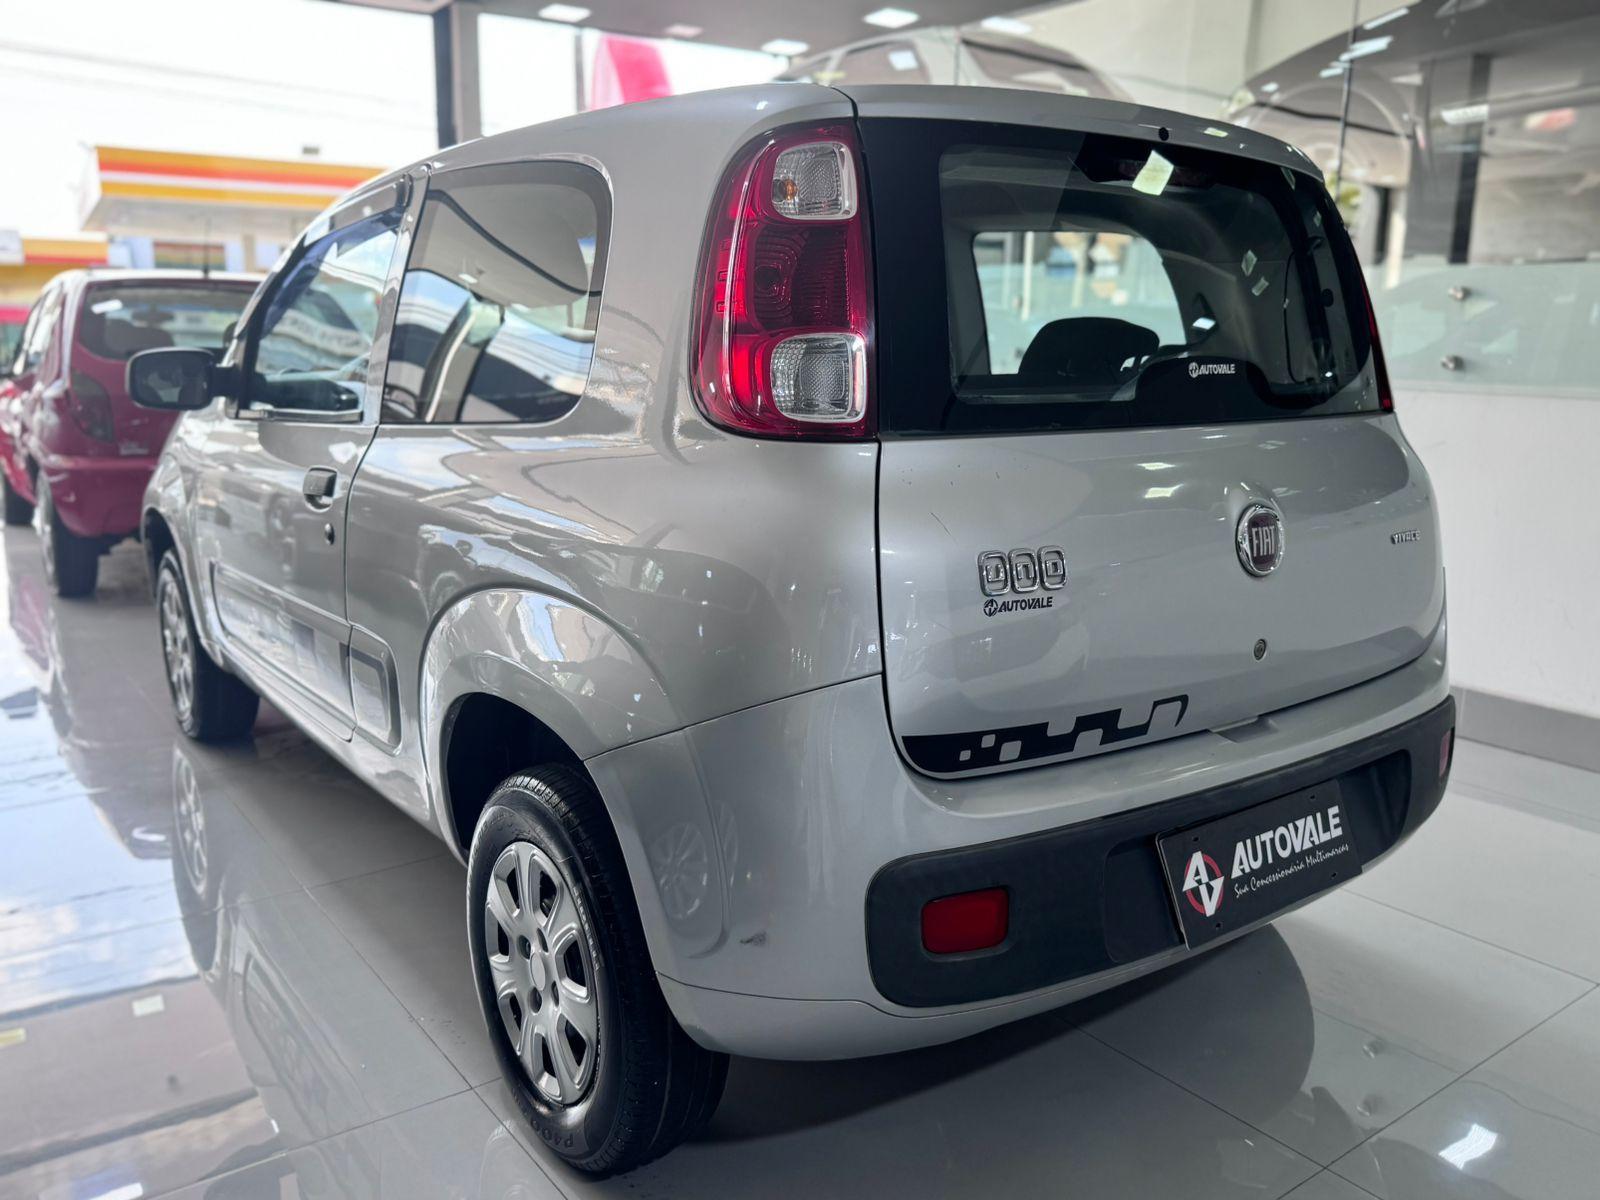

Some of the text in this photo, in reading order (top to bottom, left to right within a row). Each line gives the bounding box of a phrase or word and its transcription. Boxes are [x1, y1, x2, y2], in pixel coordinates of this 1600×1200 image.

[1199, 364, 1236, 375] AUTOVALE
[1252, 525, 1275, 557] FIAT
[998, 597, 1053, 613] AUTOVALE
[1231, 805, 1343, 879] AUTOVALE
[1234, 883, 1250, 899] Sua
[1305, 843, 1350, 869] Multimarcas
